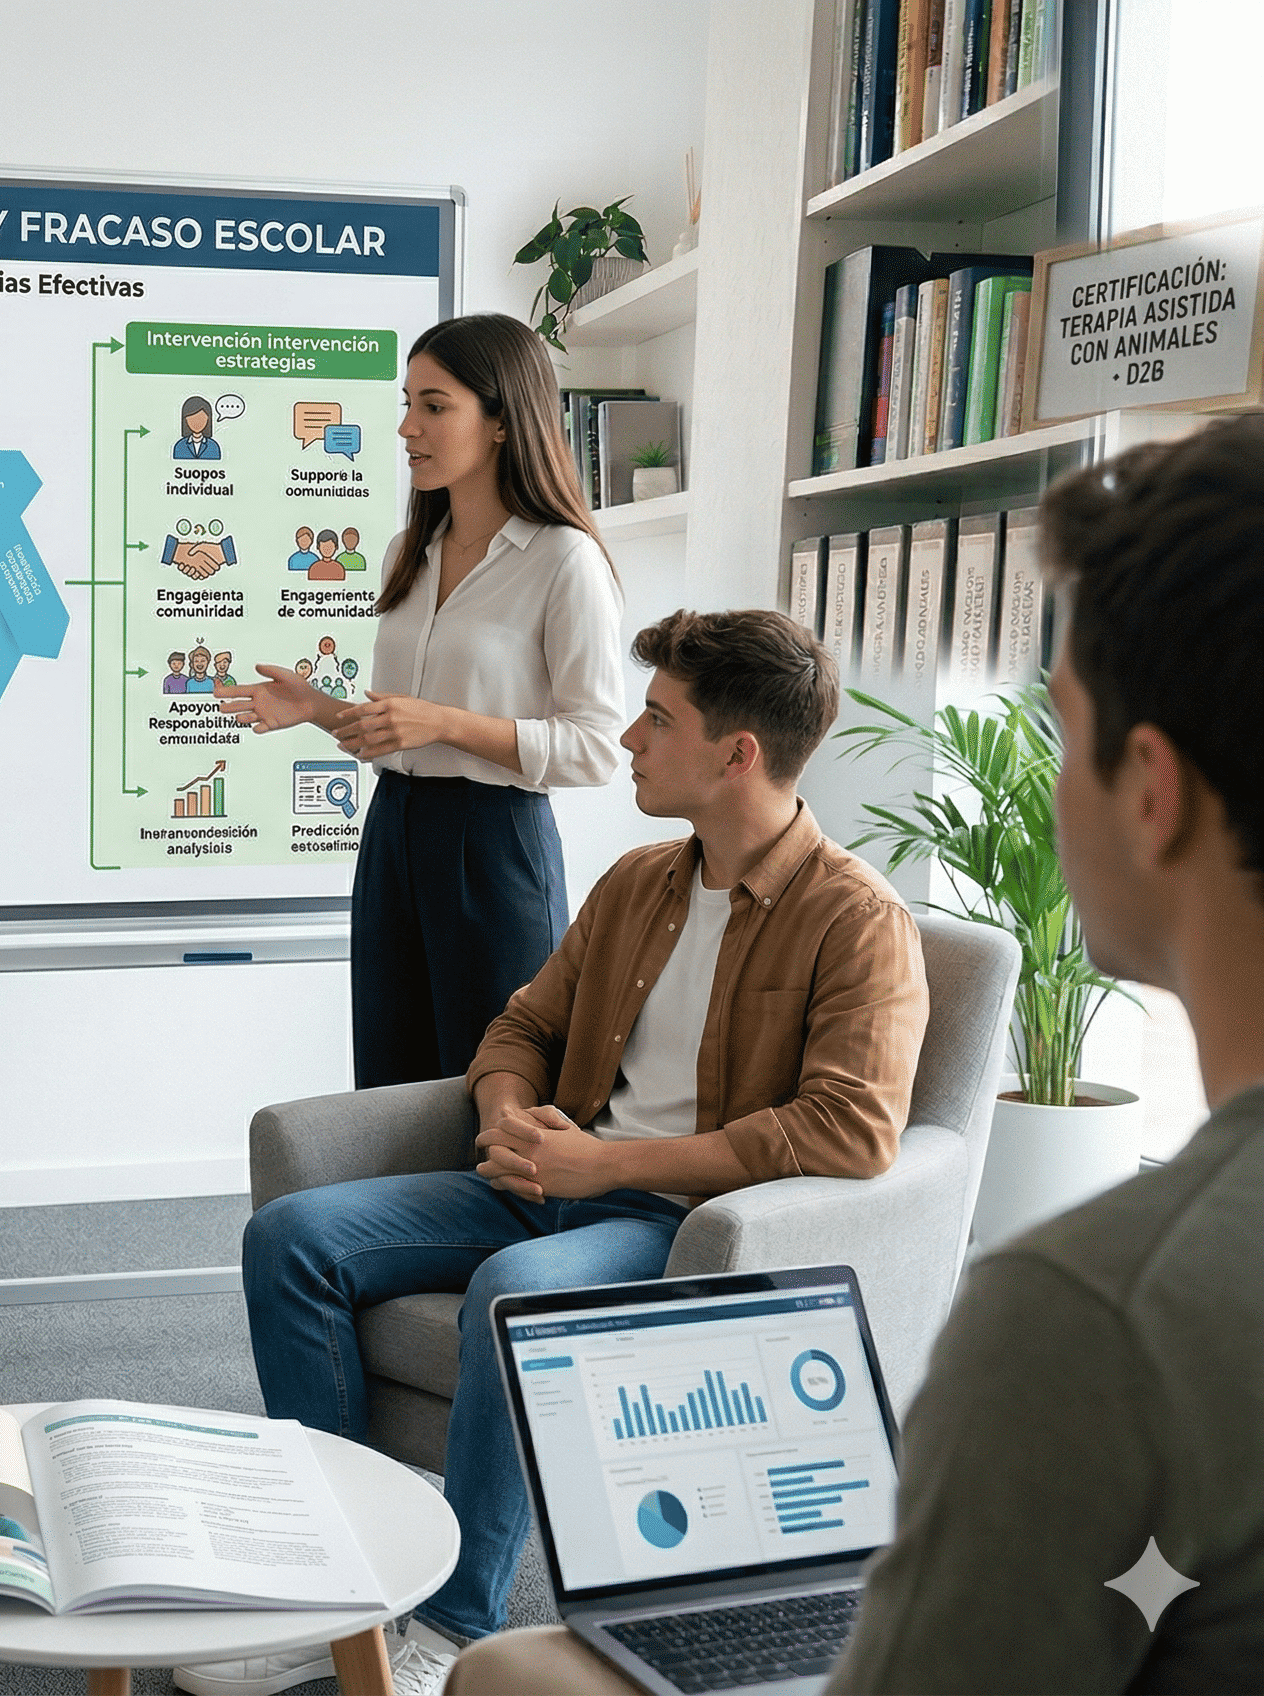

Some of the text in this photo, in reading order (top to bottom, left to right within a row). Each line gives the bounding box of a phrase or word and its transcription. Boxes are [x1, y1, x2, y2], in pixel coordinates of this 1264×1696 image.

[20, 210, 203, 249] FRACASO
[215, 220, 387, 257] ESCOLAR
[38, 272, 145, 298] Efectivas
[1072, 256, 1227, 308] CERTIFICACIÓN:
[1060, 287, 1236, 339] TERAPIA ASISTIDA
[147, 329, 380, 353] Intervención intervención
[1071, 320, 1218, 365] CON ANIMALES
[215, 353, 316, 373] estrategias
[1126, 359, 1164, 385] D2B
[352, 469, 363, 482] la
[166, 482, 234, 496] individual
[277, 604, 295, 617] de
[292, 823, 360, 837] Predicción
